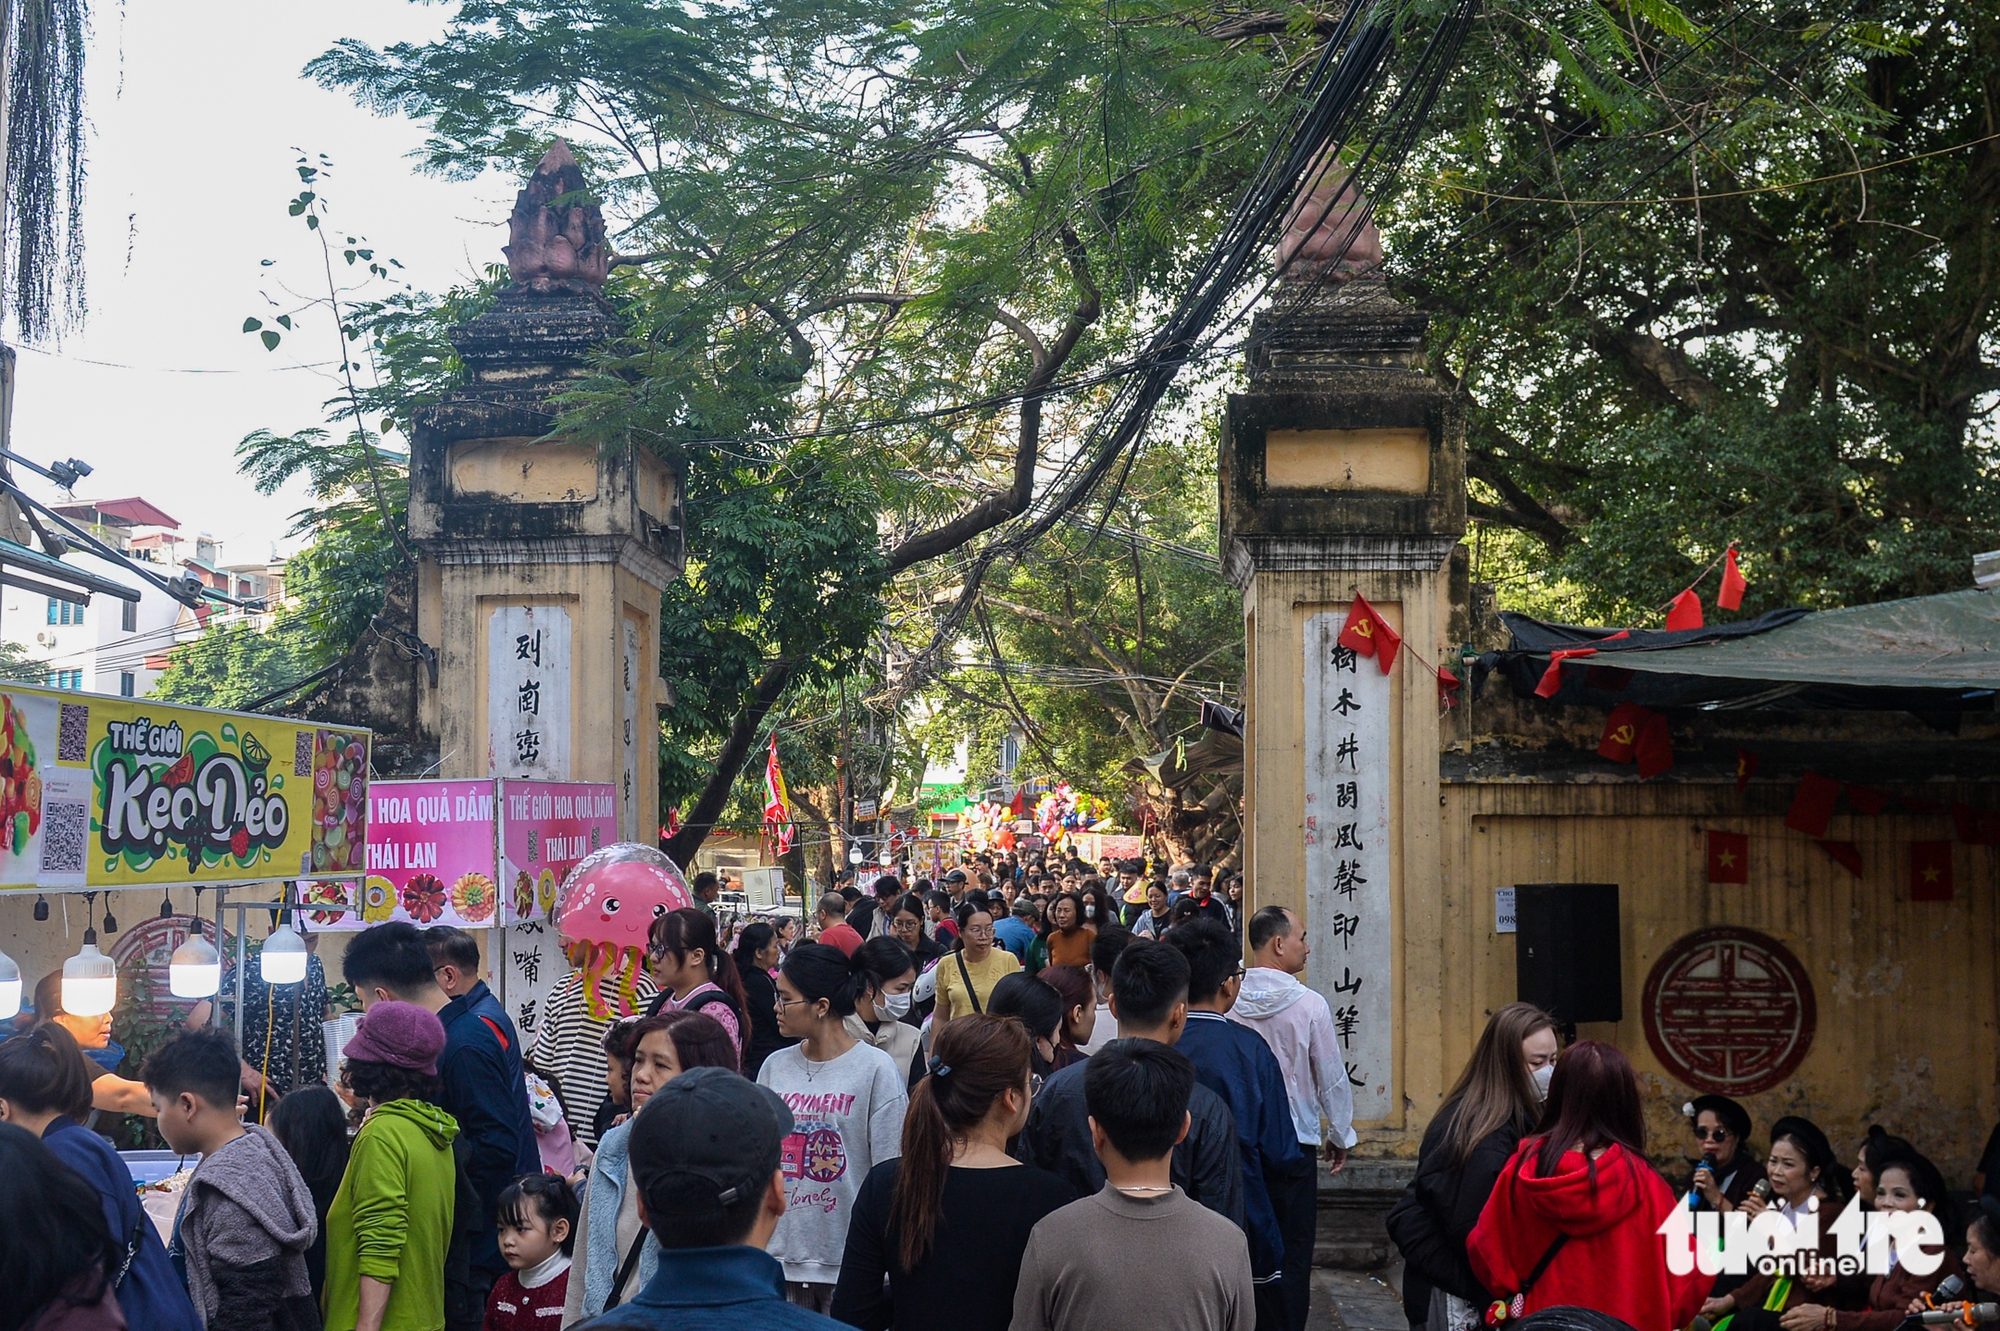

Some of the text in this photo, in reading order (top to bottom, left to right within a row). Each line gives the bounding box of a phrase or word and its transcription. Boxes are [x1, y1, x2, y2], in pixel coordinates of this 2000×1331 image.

[110, 720, 182, 754] THẾ GIỚI
[107, 763, 198, 845] Kẹo
[378, 797, 412, 824] HOA
[416, 787, 451, 826] QUẢ
[455, 786, 493, 822] DẦM
[509, 787, 530, 820] THẾ
[532, 790, 552, 820] GIỚI
[554, 795, 574, 820] HOA
[575, 788, 593, 821] QUẢ
[404, 842, 437, 869] LAN
[545, 832, 587, 862] THÁI LAN
